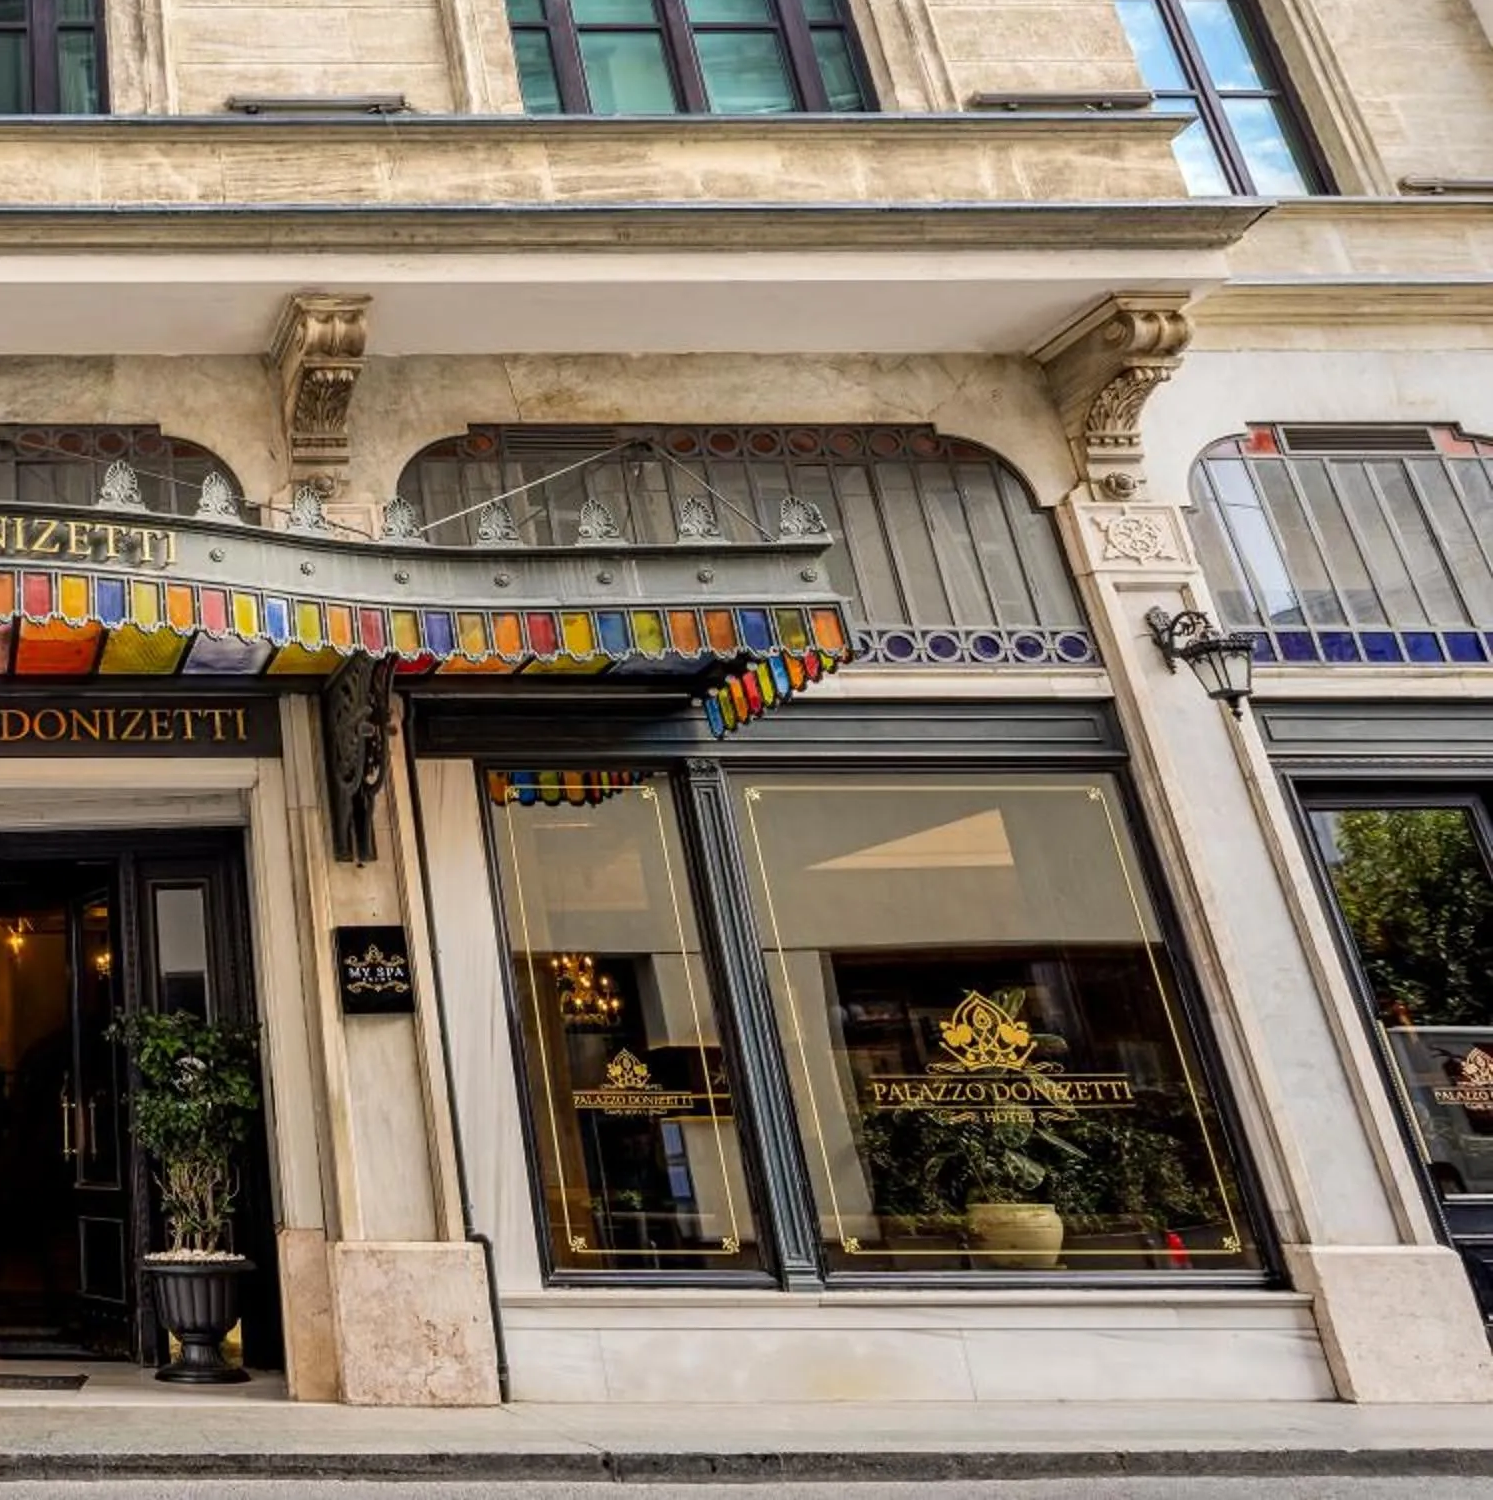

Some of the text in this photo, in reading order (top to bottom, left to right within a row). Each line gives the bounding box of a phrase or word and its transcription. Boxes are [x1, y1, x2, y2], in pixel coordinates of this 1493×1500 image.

[0, 709, 247, 741] DONIZETTI
[349, 966, 404, 978] MY SPA
[874, 1080, 1135, 1101] PALAZZO DONIZETTI
[573, 1095, 693, 1105] PALAZZO DONIZETTI
[985, 1111, 1036, 1124] HOTEL
